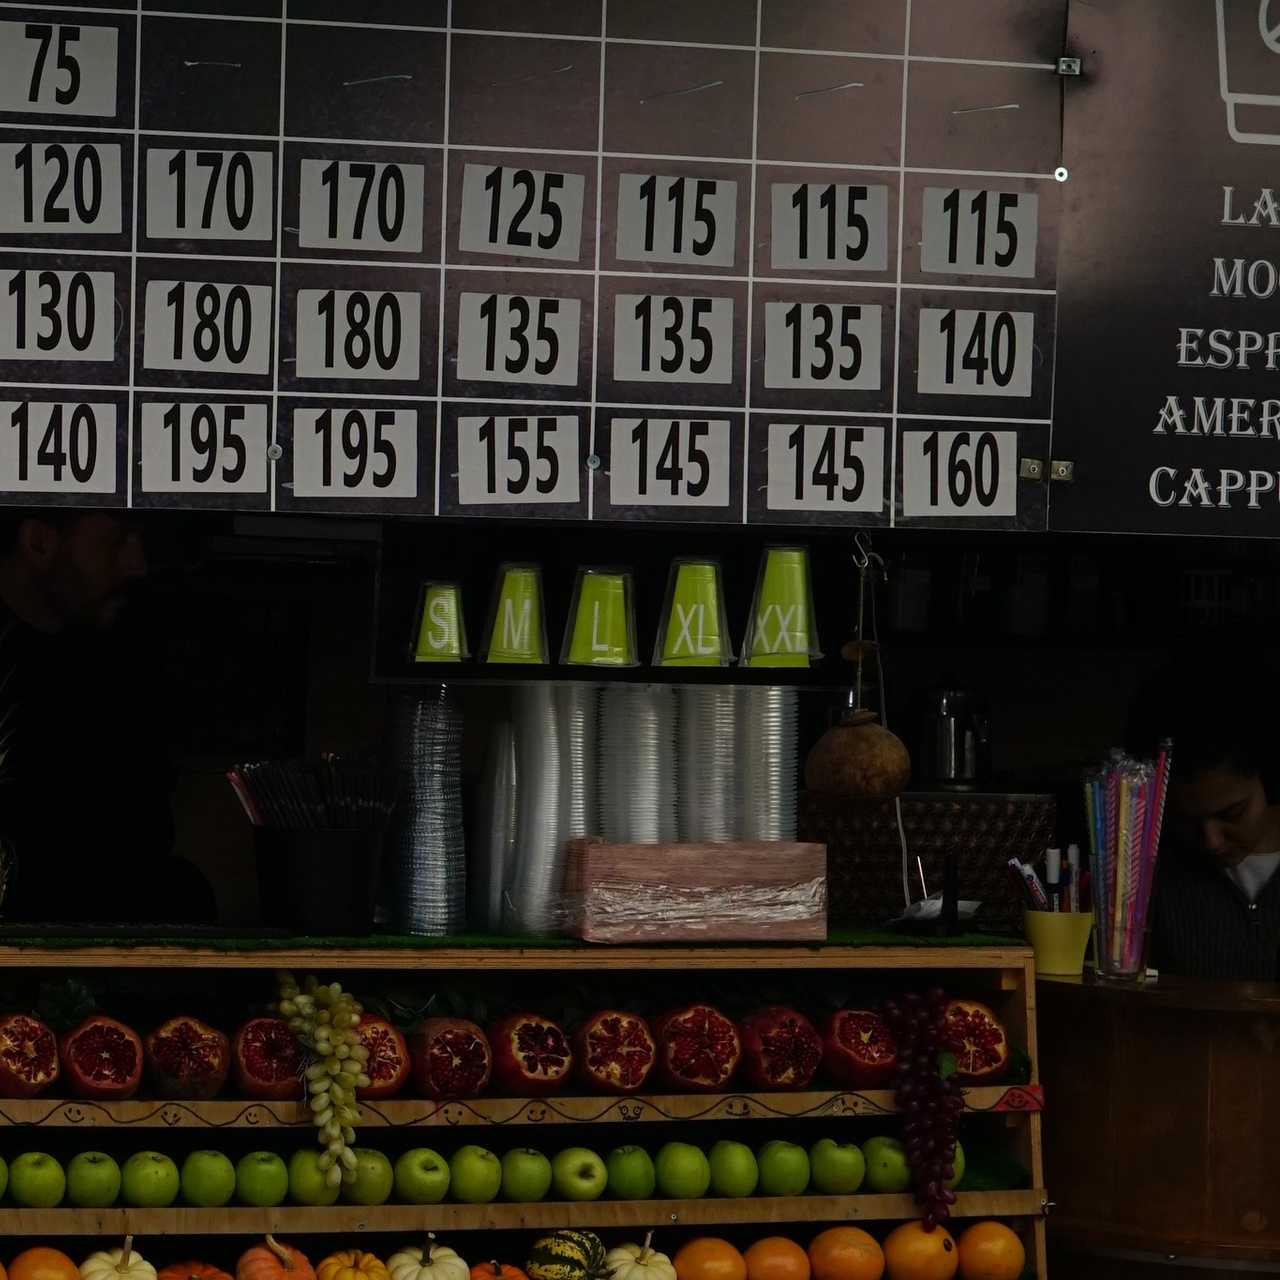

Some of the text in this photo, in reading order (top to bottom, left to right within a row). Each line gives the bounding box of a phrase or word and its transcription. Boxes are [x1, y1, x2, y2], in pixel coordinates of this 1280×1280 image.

[25, 26, 80, 105] 75
[15, 143, 102, 224] 120
[169, 150, 254, 231] 170
[322, 162, 405, 243] 170
[485, 167, 563, 249] 125
[639, 175, 716, 256] 115
[792, 184, 868, 261] 115
[1222, 186, 1280, 226] LA
[943, 190, 1018, 267] 115
[8, 270, 95, 351] 130
[1210, 258, 1280, 297] MO
[167, 282, 251, 364] 180
[318, 291, 401, 371] 180
[480, 294, 559, 375] 135
[635, 296, 713, 375] 135
[785, 303, 861, 381] 135
[940, 310, 1016, 388] 140
[11, 403, 96, 484] 140
[163, 404, 246, 484] 195
[315, 409, 396, 488] 195
[479, 417, 559, 494] 155
[1153, 396, 1280, 440] AMER
[632, 420, 709, 497] 145
[789, 425, 864, 502] 145
[923, 432, 999, 507] 160
[1150, 467, 1280, 508] CAPP
[428, 600, 452, 650] S
[503, 599, 531, 649] M
[592, 600, 609, 650] L
[675, 604, 715, 654] XL
